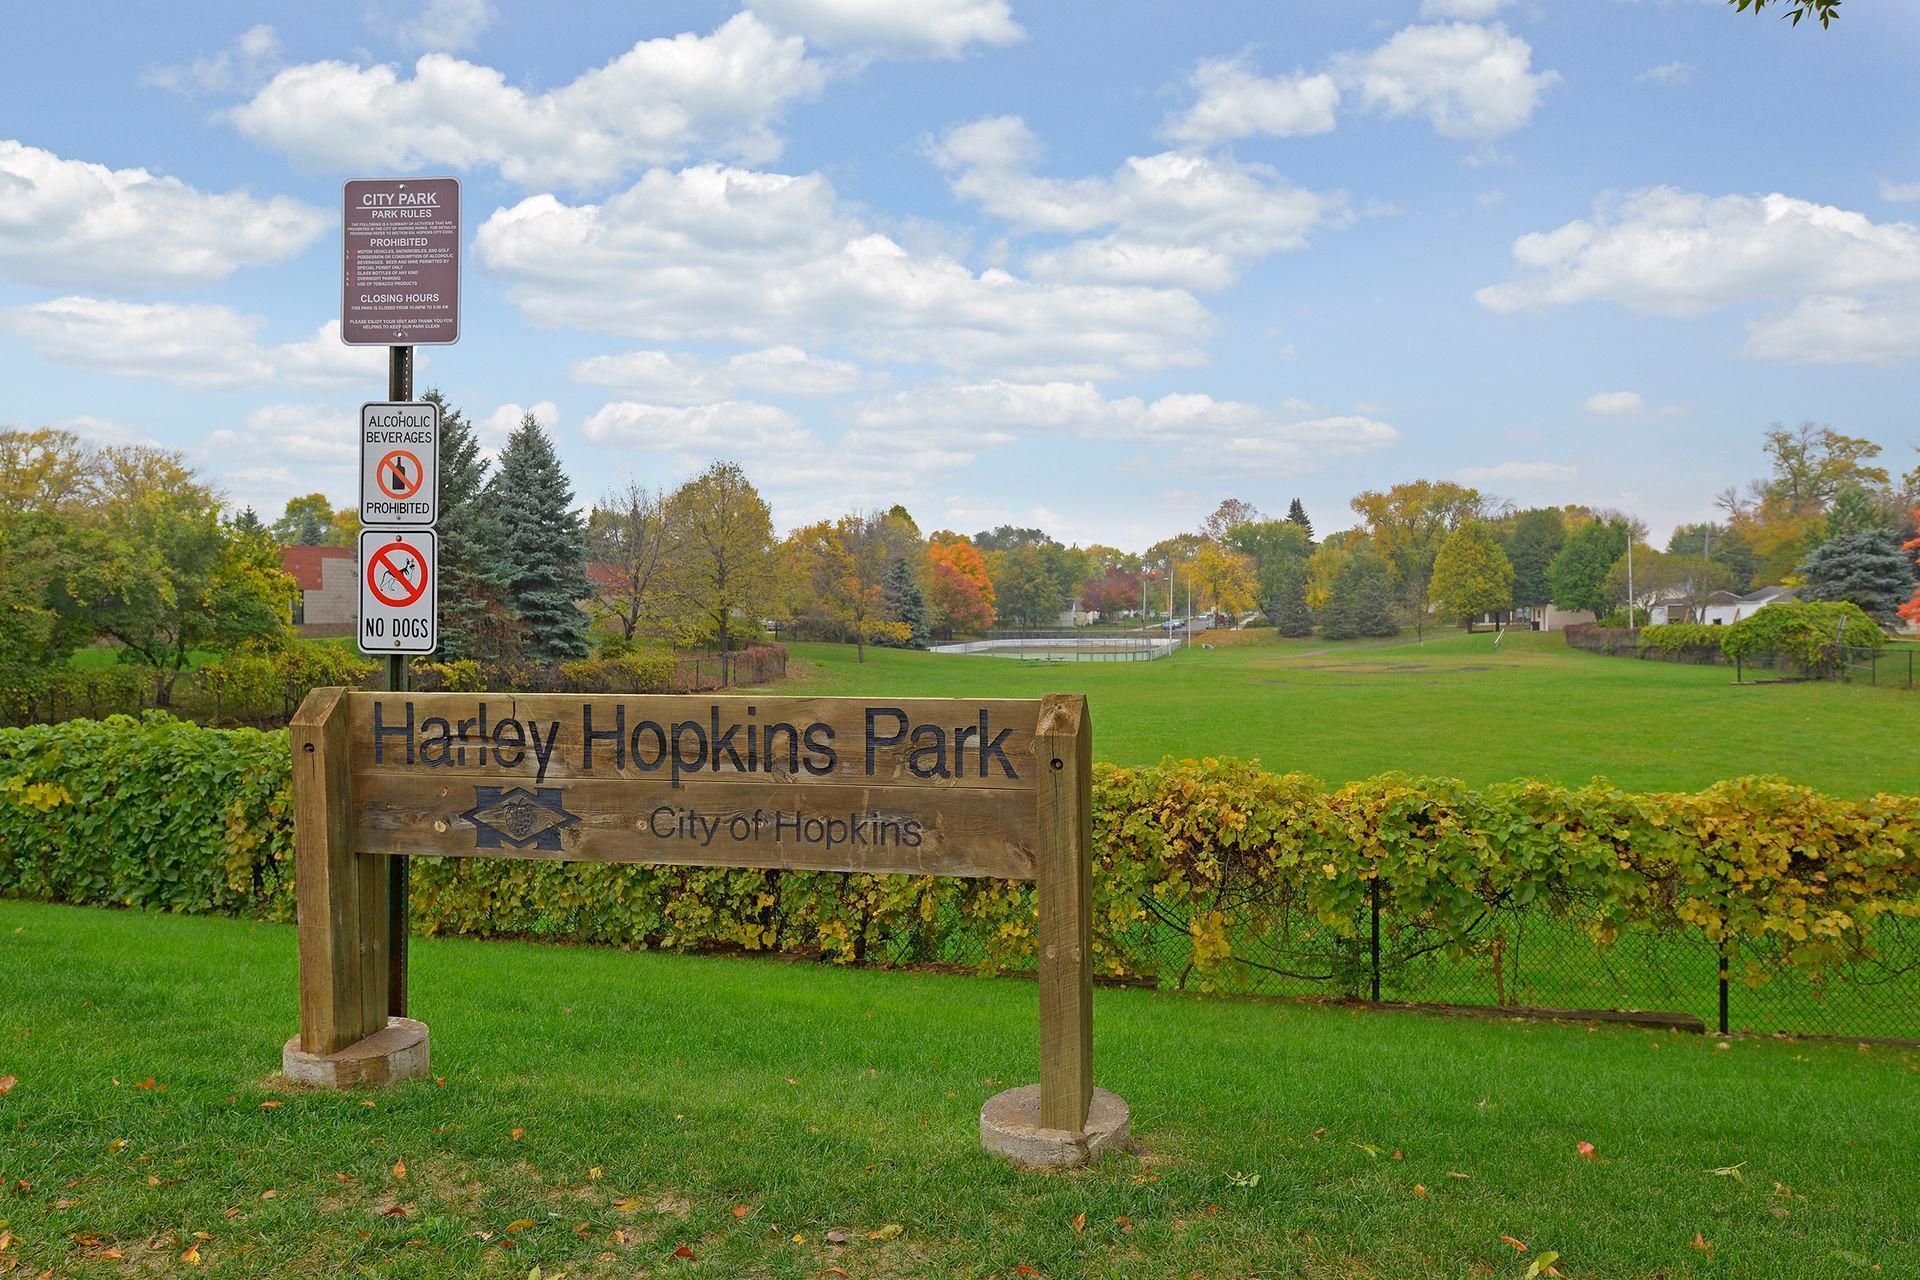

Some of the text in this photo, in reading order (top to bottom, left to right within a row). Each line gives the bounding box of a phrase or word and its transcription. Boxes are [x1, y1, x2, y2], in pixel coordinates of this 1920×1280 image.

[363, 192, 437, 205] CITY PARK
[372, 209, 432, 218] PARK RULES
[370, 238, 428, 246] PROHIBITED
[360, 294, 439, 302] CLOSING HOURS
[368, 416, 430, 427] ALCOHOLIC
[366, 432, 432, 443] BEVERAGES
[366, 502, 430, 514] PROHIBITED
[366, 618, 428, 638] NO DOGS
[374, 701, 1019, 789] Harley Hopkins Park
[650, 806, 923, 850] City of Hopkins
